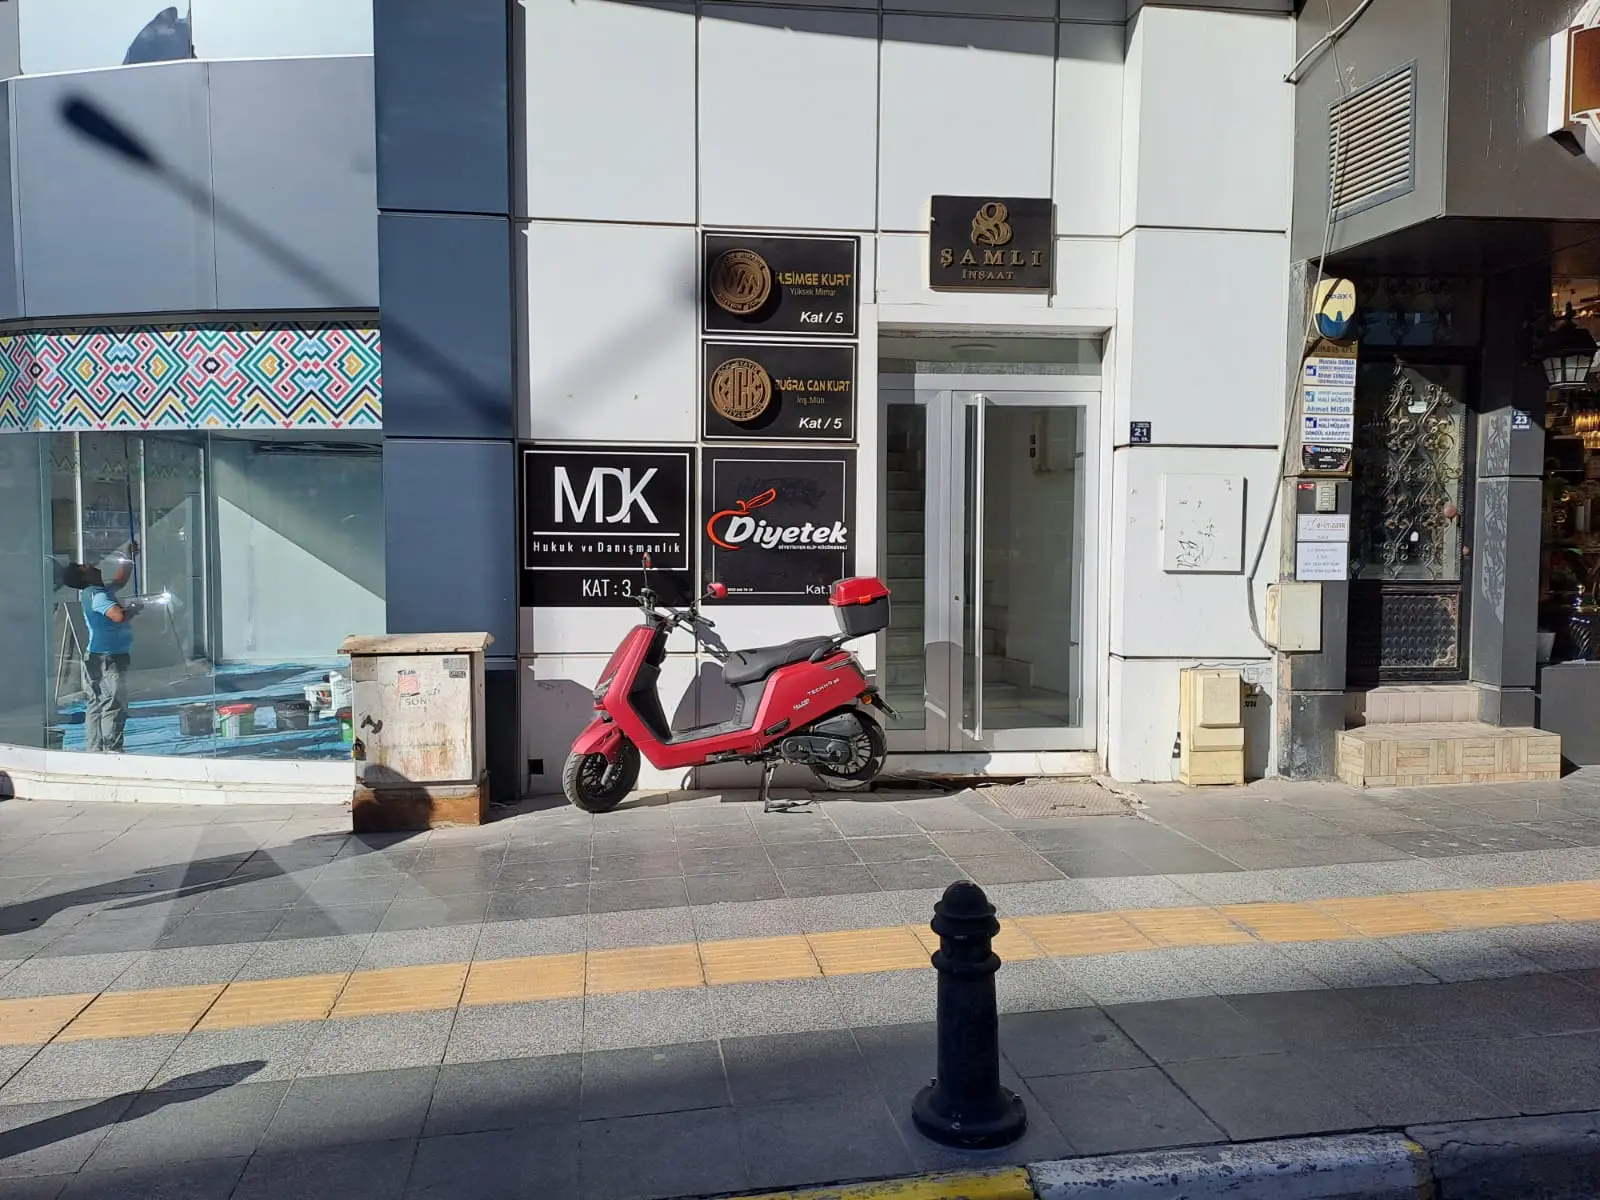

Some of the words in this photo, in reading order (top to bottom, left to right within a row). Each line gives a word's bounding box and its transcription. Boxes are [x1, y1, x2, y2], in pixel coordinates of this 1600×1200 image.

[940, 247, 1043, 268] ŞAMLI
[821, 273, 852, 286] KURT
[800, 311, 824, 323] Kat
[825, 312, 833, 323] /
[834, 312, 844, 324] 5
[807, 379, 826, 392] CAN
[827, 380, 851, 392] KURT
[798, 417, 822, 429] Kat
[823, 417, 832, 429] /
[833, 418, 843, 429] 5
[1515, 415, 1528, 424] 23
[1134, 428, 1147, 436] 21
[554, 466, 660, 524] MDK
[724, 515, 848, 549] Diyetek
[533, 541, 574, 552] Hukuk
[581, 544, 593, 552] ve
[597, 541, 680, 555] Danışmanlık
[582, 578, 611, 597] KAT
[621, 579, 632, 597] 3
